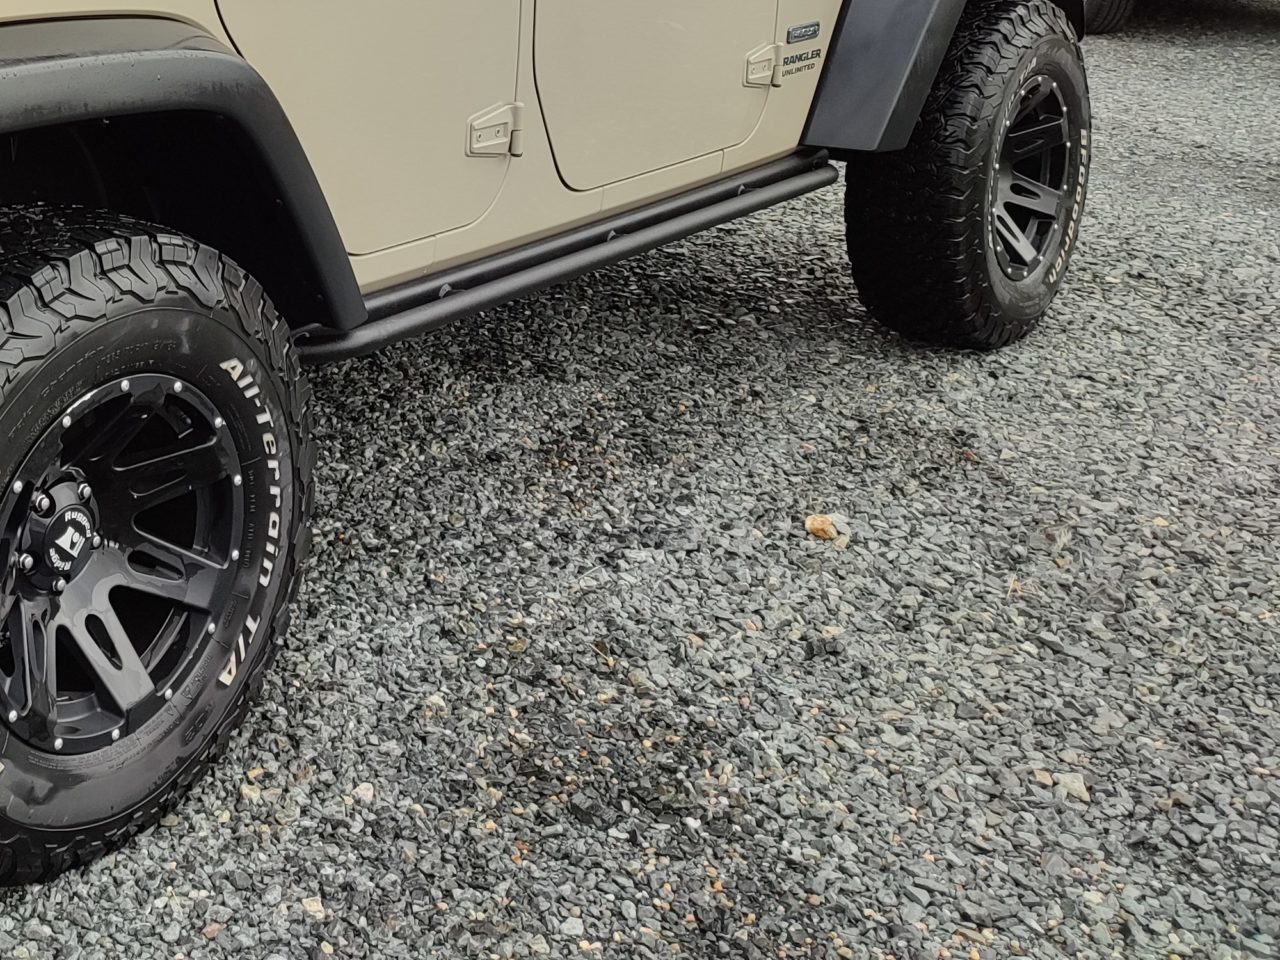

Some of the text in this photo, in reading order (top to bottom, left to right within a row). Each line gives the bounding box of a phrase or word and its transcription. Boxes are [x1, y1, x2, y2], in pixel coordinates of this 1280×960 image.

[781, 62, 816, 77] UNLIMITED
[782, 48, 822, 66] RANGLER
[220, 358, 282, 588] All-Terrain
[65, 510, 92, 538] Rugged
[218, 614, 261, 686] T/A
